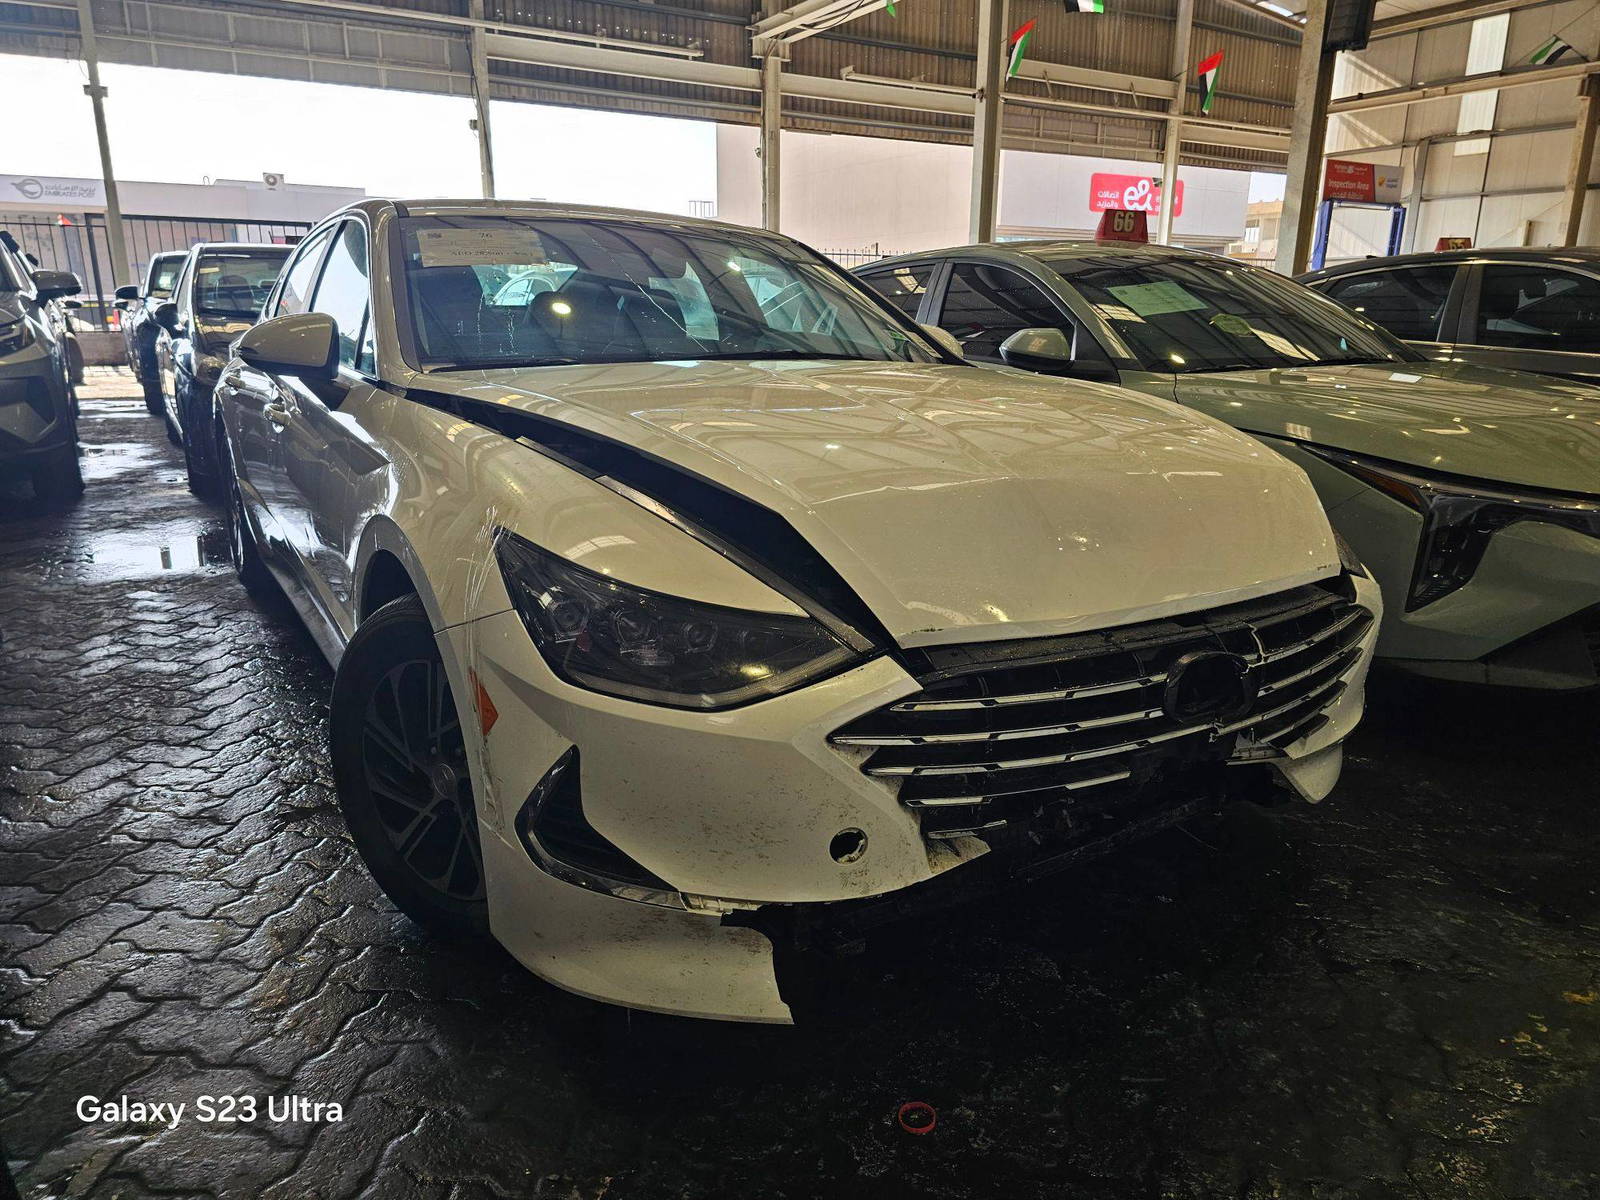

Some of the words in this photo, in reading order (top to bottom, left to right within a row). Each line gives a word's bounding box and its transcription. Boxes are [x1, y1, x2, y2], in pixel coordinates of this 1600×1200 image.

[1328, 179, 1357, 190] Inspection
[1357, 181, 1370, 190] Area
[44, 190, 77, 198] EMIRATES
[1097, 190, 1120, 199] اتصالات
[1113, 211, 1135, 232] 66
